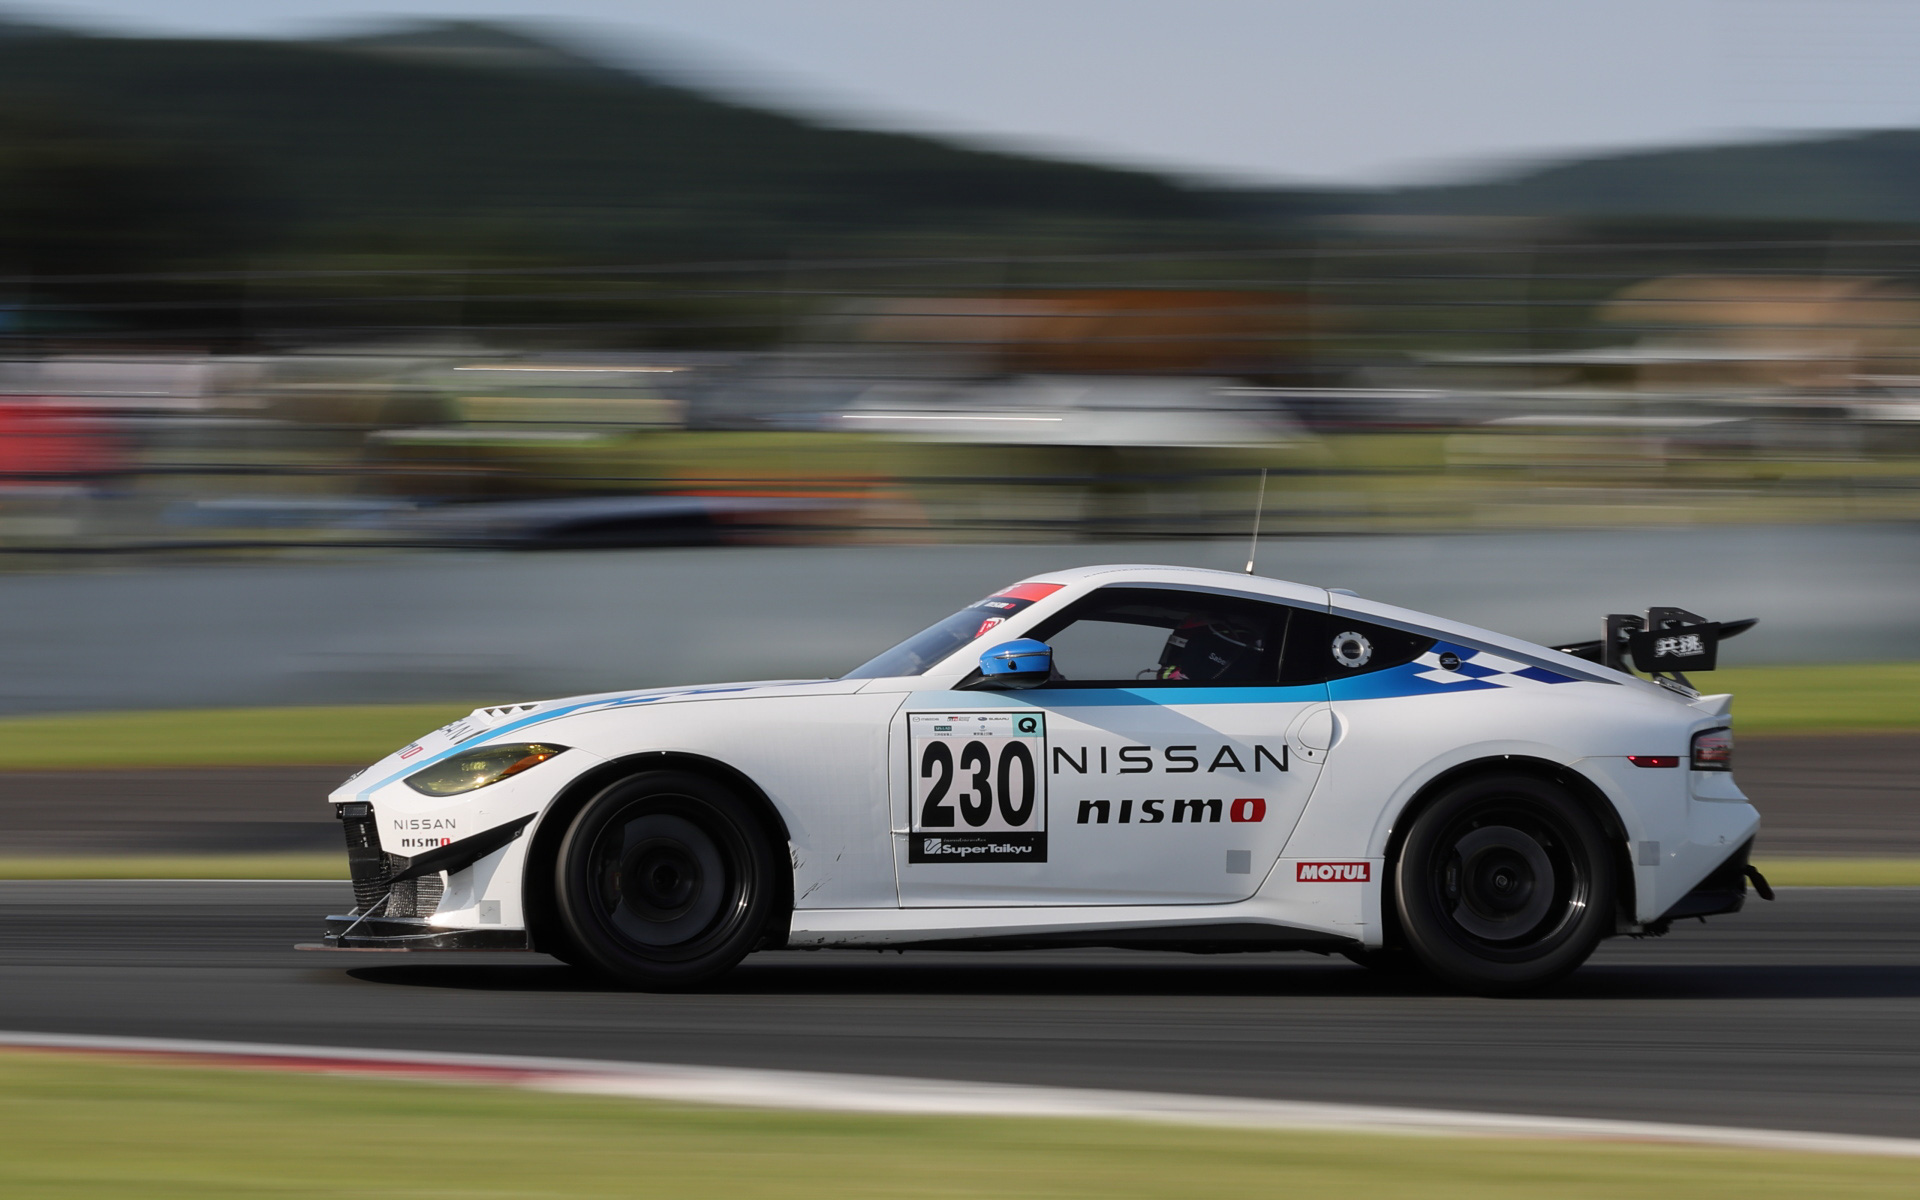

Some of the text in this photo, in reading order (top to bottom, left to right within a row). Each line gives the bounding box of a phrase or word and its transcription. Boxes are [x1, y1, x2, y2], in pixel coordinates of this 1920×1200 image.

[1018, 717, 1037, 733] Q
[1053, 744, 1289, 774] NISSAN
[921, 740, 1035, 827] 230
[394, 818, 456, 830] NISSAN
[1299, 864, 1368, 881] MOTUL
